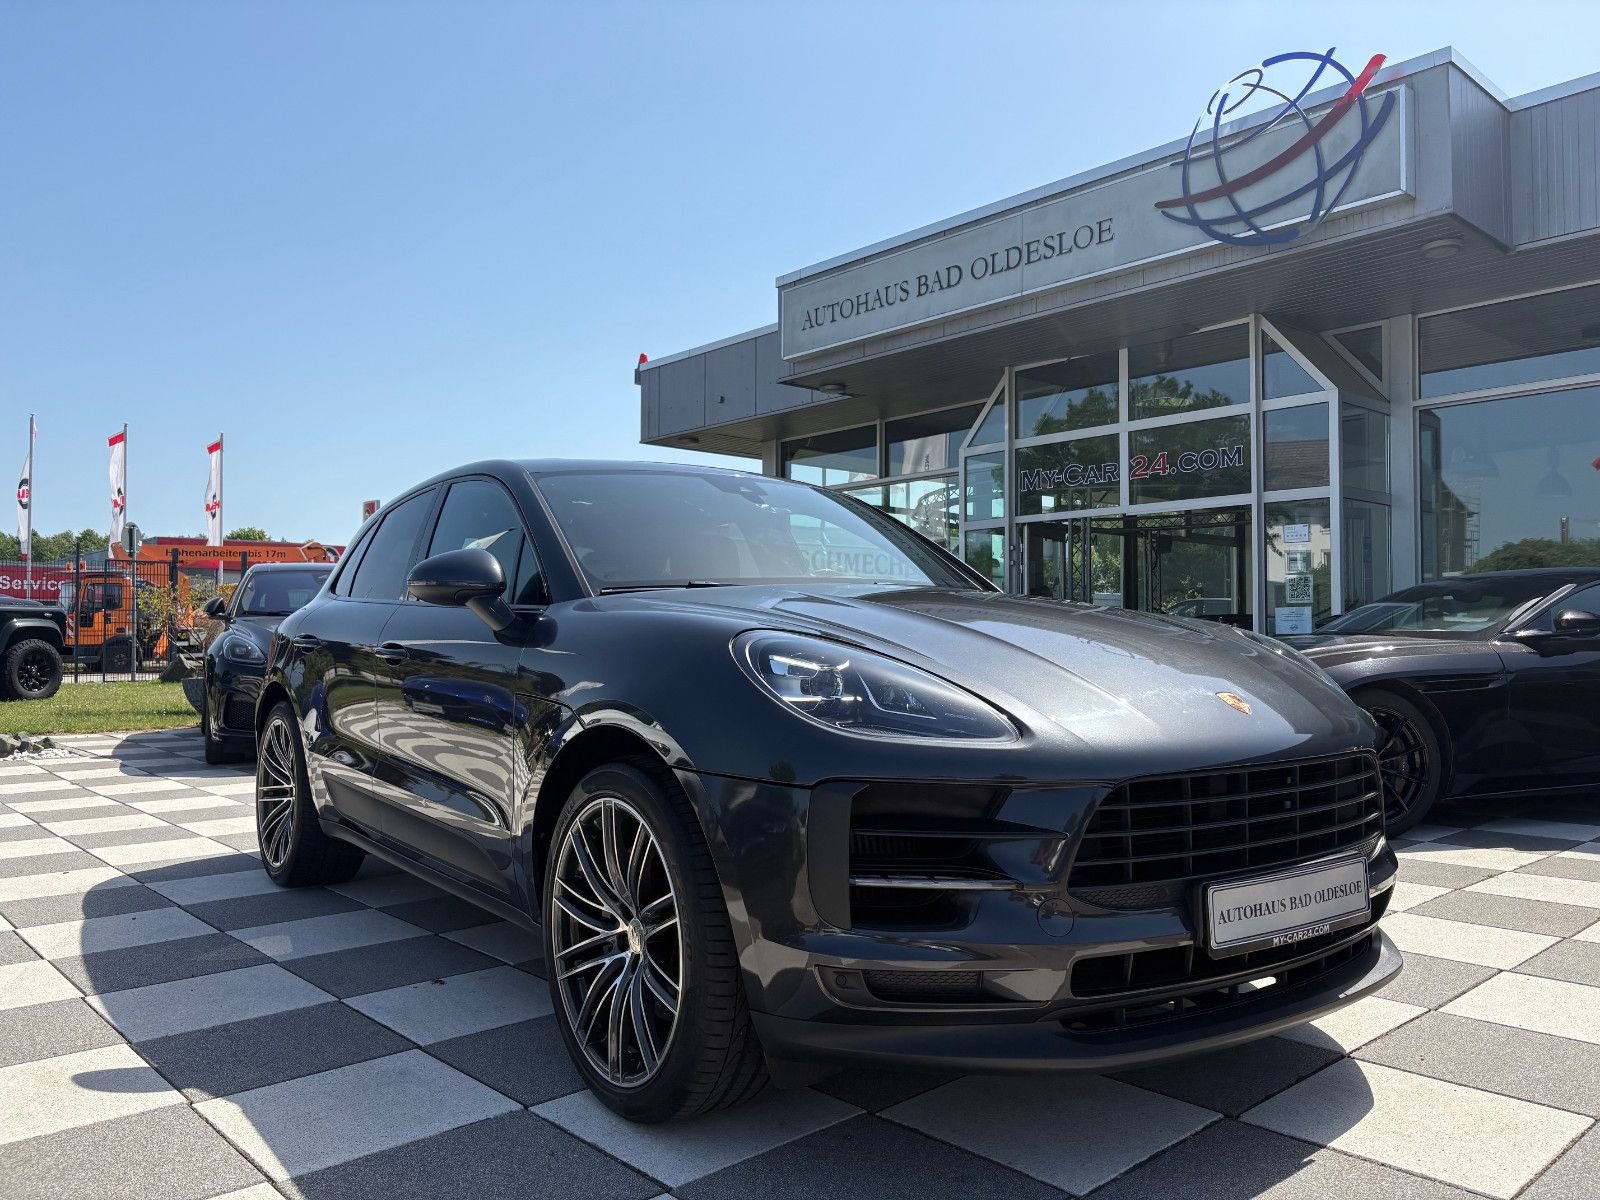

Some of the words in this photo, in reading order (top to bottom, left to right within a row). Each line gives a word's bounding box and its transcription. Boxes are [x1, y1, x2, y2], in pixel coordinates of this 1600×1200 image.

[801, 279, 910, 331] AUTOHAUS
[915, 263, 963, 298] BAD
[970, 217, 1116, 281] OLDESLOE
[265, 550, 287, 559] 17m
[1217, 898, 1287, 926] AUTOHAUS
[1289, 892, 1312, 911] BAD
[1314, 880, 1363, 905] OLDESLOE
[1272, 924, 1330, 947] MY-CAR24.COM
